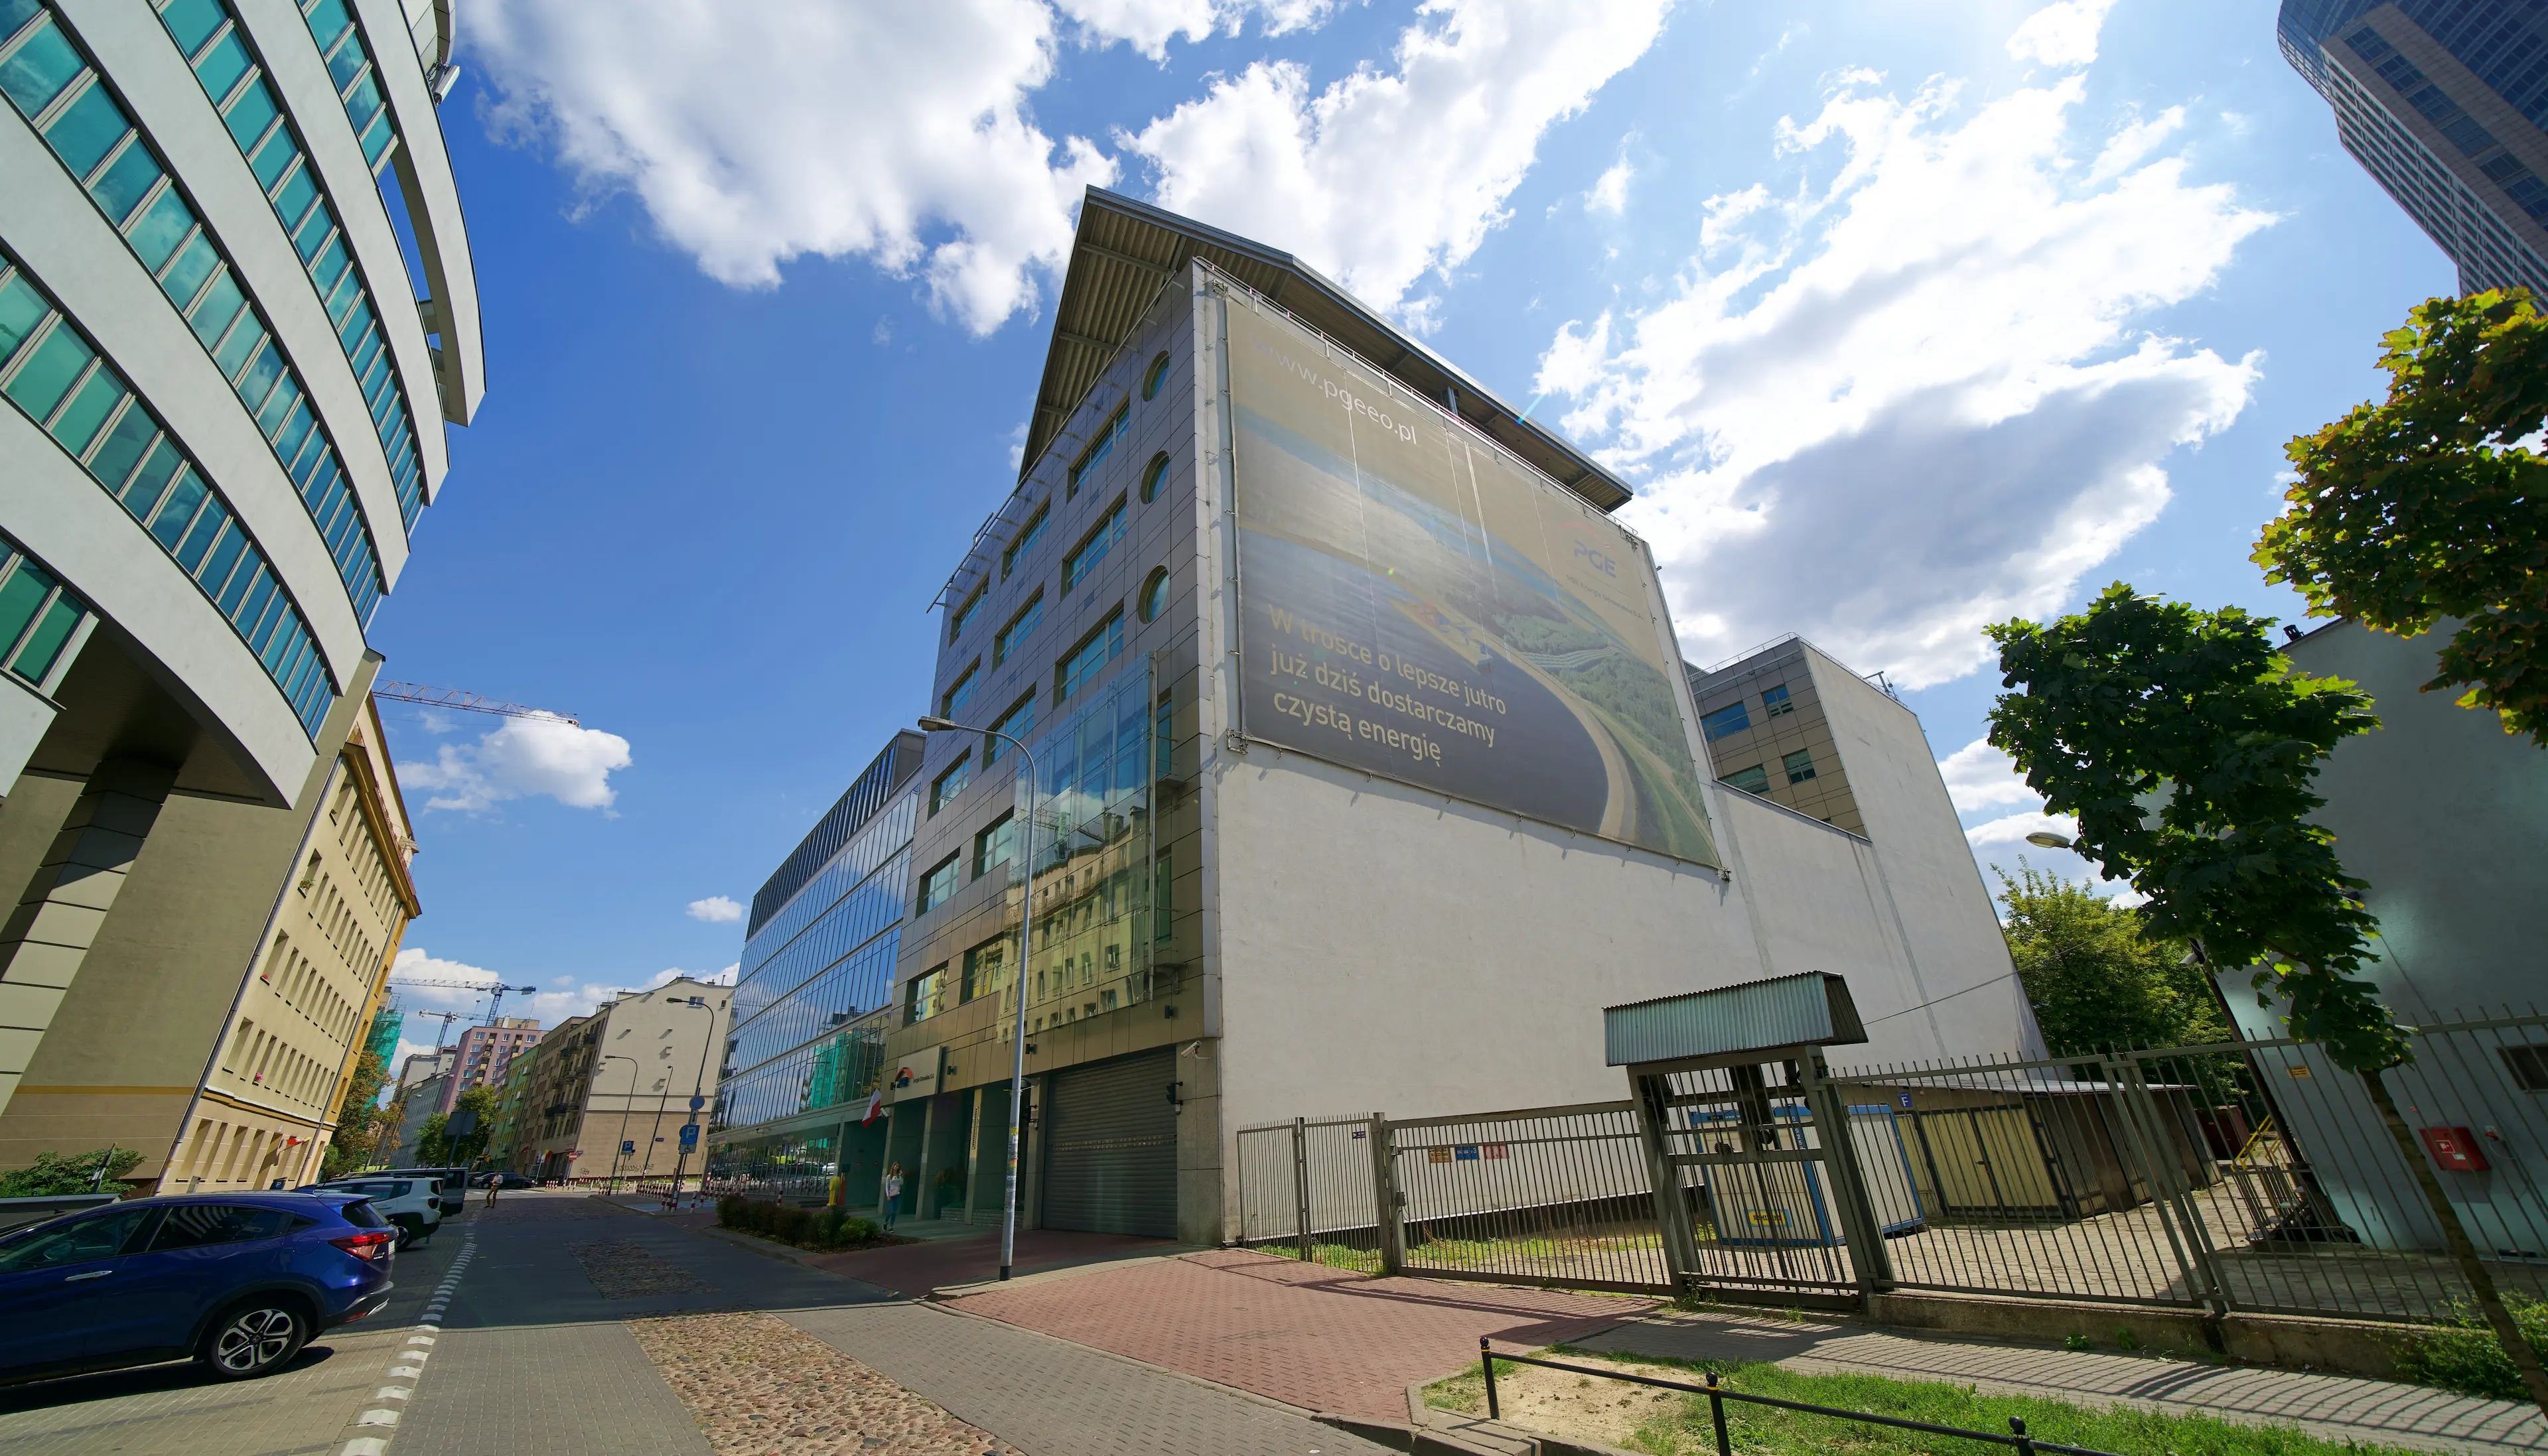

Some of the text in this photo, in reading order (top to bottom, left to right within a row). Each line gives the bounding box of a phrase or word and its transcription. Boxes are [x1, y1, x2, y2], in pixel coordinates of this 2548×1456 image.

[1251, 333, 1417, 445] www.pgeeo.pl
[1268, 604, 1506, 715] W trosce o lepsze jutro
[1270, 643, 1495, 748] już dziś dostarczamy
[1274, 692, 1441, 767] czystą energię
[685, 1126, 697, 1139] P
[1901, 1096, 1908, 1106] F
[624, 1142, 631, 1150] P
